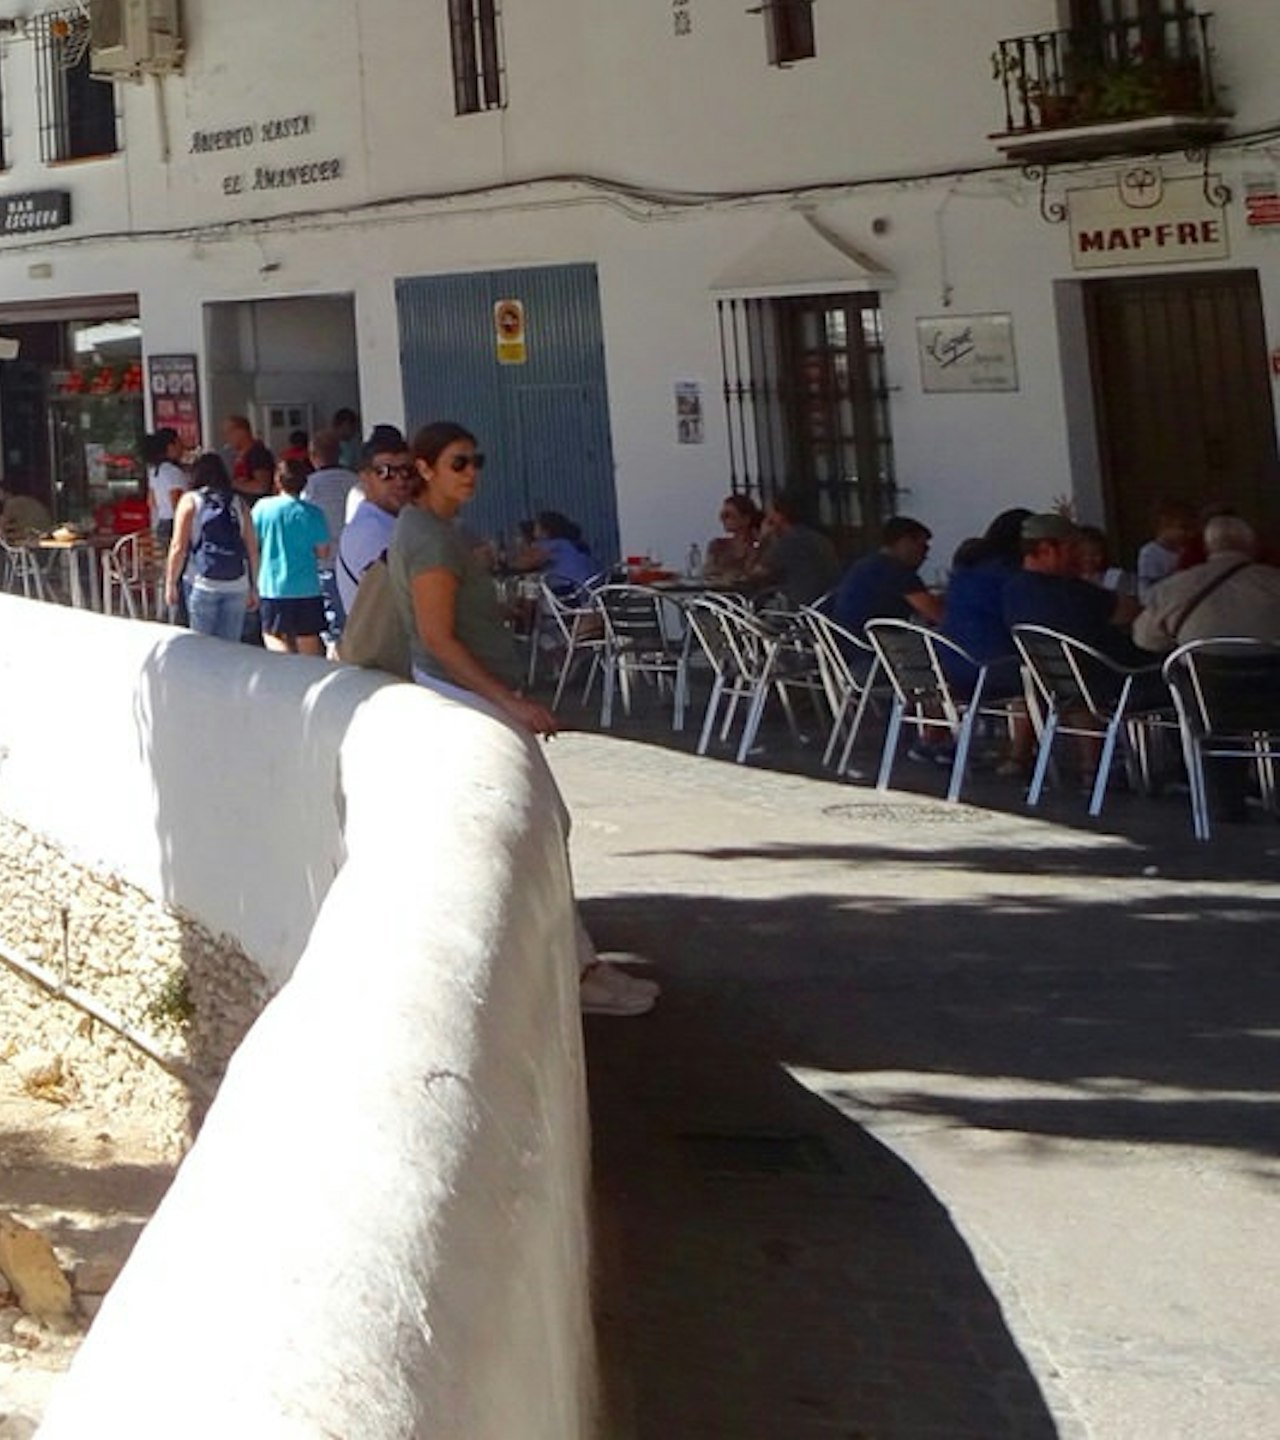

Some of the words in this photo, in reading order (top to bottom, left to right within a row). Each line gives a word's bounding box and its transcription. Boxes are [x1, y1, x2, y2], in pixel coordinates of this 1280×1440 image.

[262, 115, 310, 142] HASTA
[224, 175, 242, 195] EL
[253, 158, 341, 191] AMANECER
[7, 200, 34, 213] BAR
[1079, 220, 1220, 253] MAPFRE
